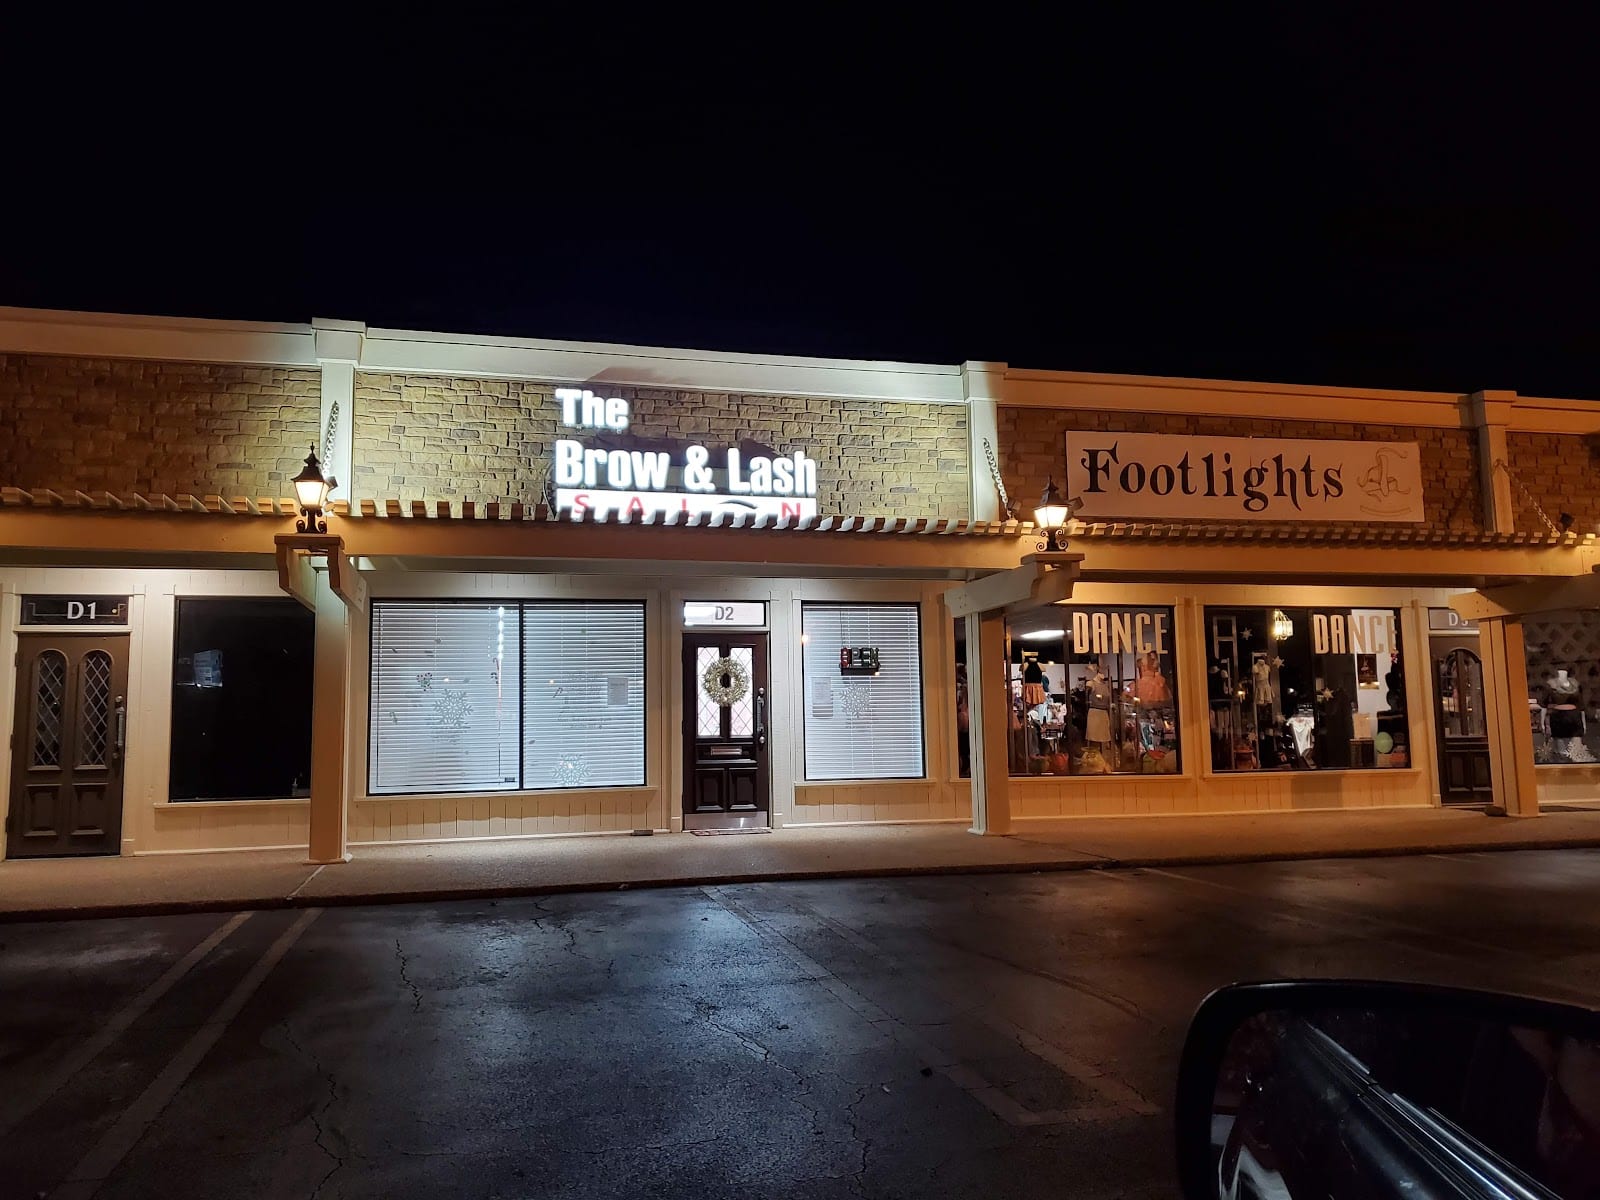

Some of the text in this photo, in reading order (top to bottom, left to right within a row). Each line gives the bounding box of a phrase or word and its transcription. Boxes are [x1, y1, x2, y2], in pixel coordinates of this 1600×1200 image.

[555, 388, 629, 429] The
[555, 439, 817, 496] Brow & Lash
[1080, 440, 1344, 513] Footlights
[574, 493, 801, 518] SALN
[66, 601, 97, 620] D1
[714, 606, 734, 621] D2
[1072, 612, 1169, 654] DANCE
[1313, 614, 1398, 654] DANCE
[841, 647, 879, 668] OPEN
